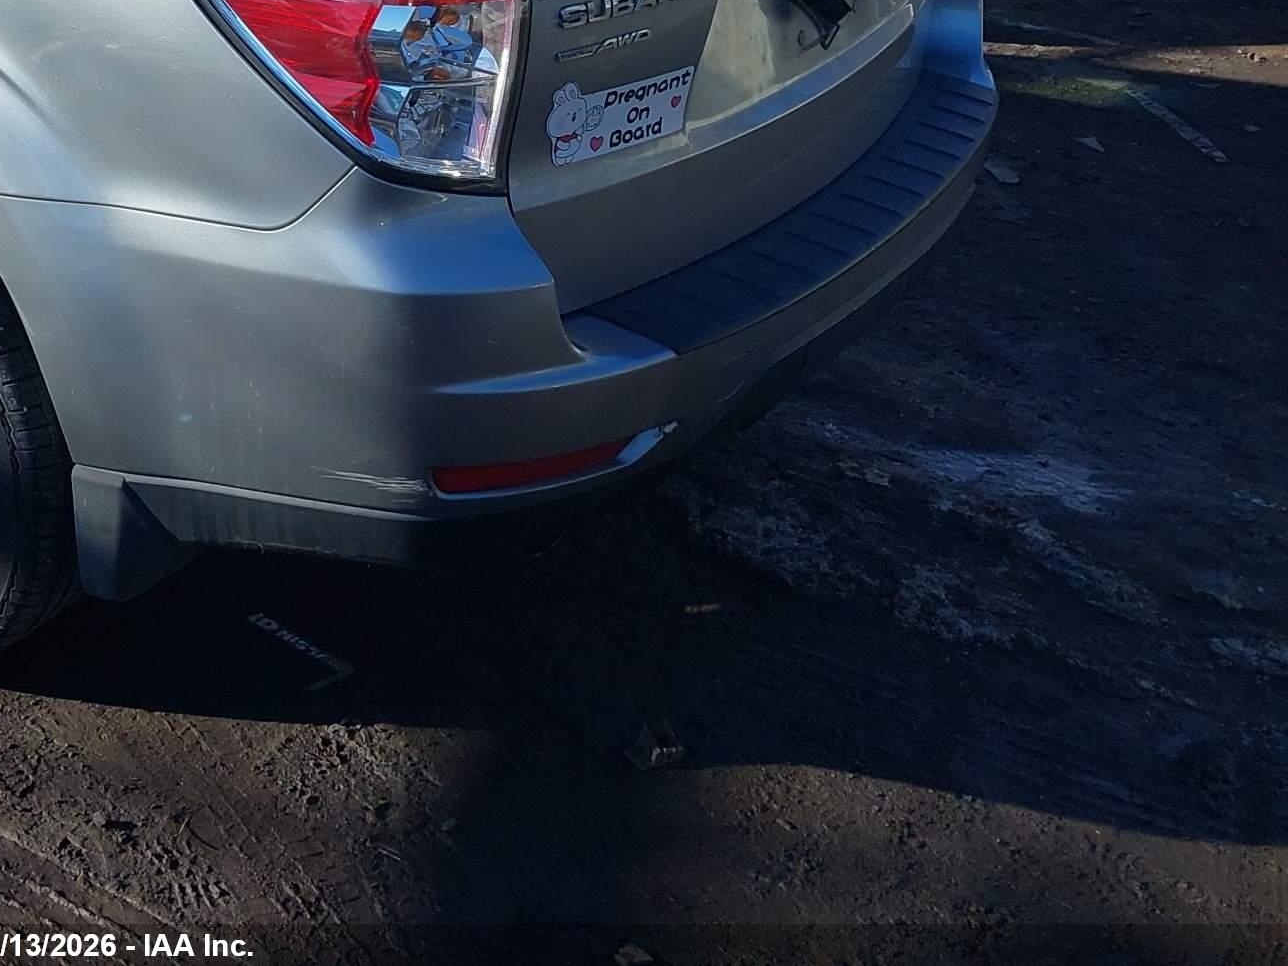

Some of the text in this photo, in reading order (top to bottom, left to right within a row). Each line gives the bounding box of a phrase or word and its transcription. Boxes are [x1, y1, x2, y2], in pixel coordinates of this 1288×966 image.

[596, 28, 653, 54] AWD
[604, 69, 692, 108] Pregnant
[626, 105, 650, 124] On
[609, 117, 663, 148] Board
